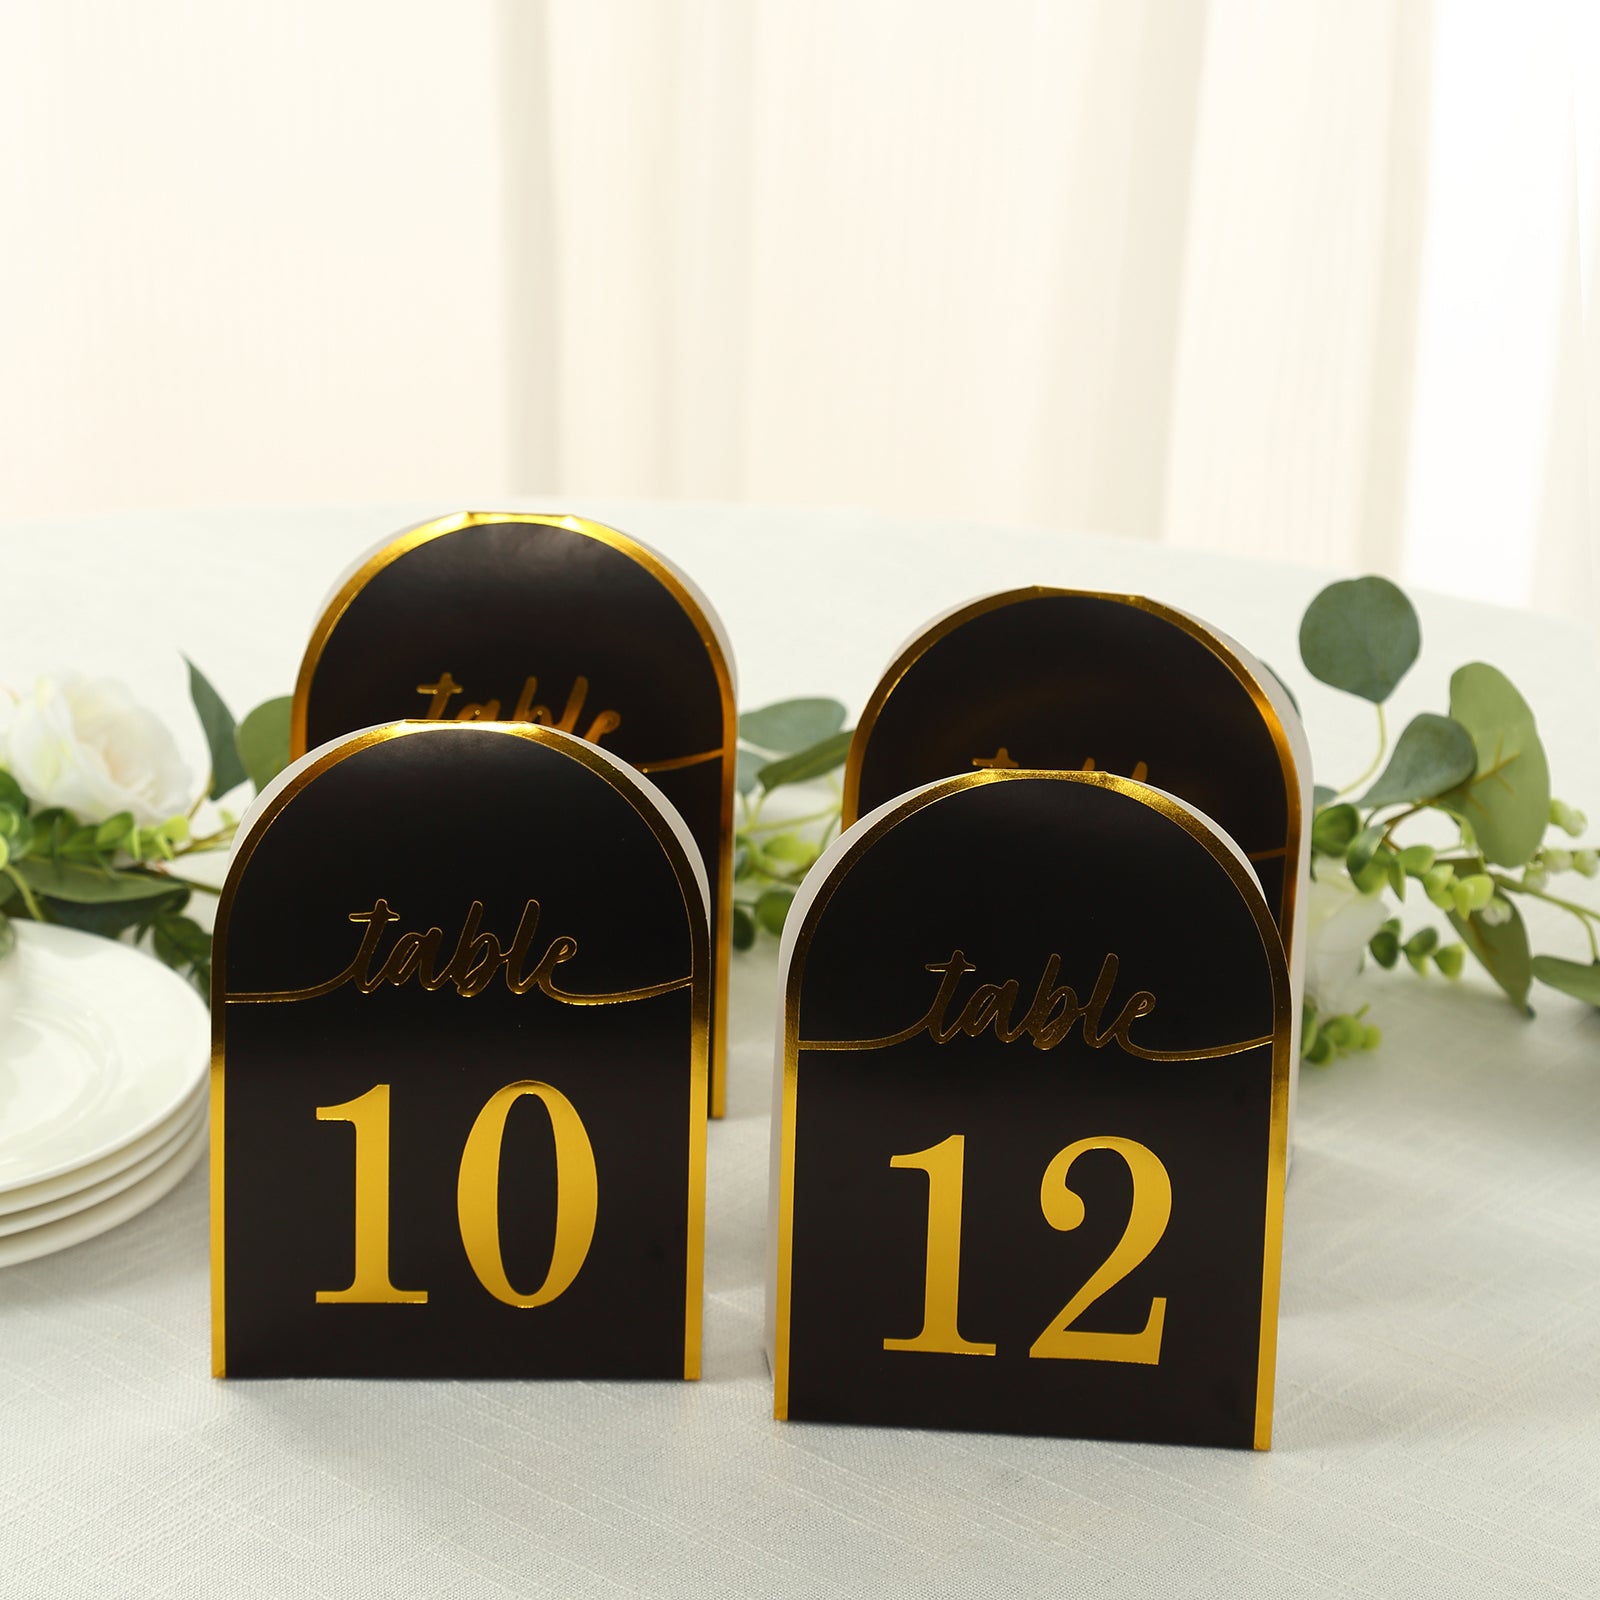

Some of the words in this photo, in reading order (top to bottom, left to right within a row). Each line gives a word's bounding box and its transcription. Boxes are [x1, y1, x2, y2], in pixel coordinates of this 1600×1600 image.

[347, 897, 580, 1003] table
[923, 948, 1158, 1055] table
[316, 1080, 598, 1308] 10
[883, 1135, 1172, 1365] 12
